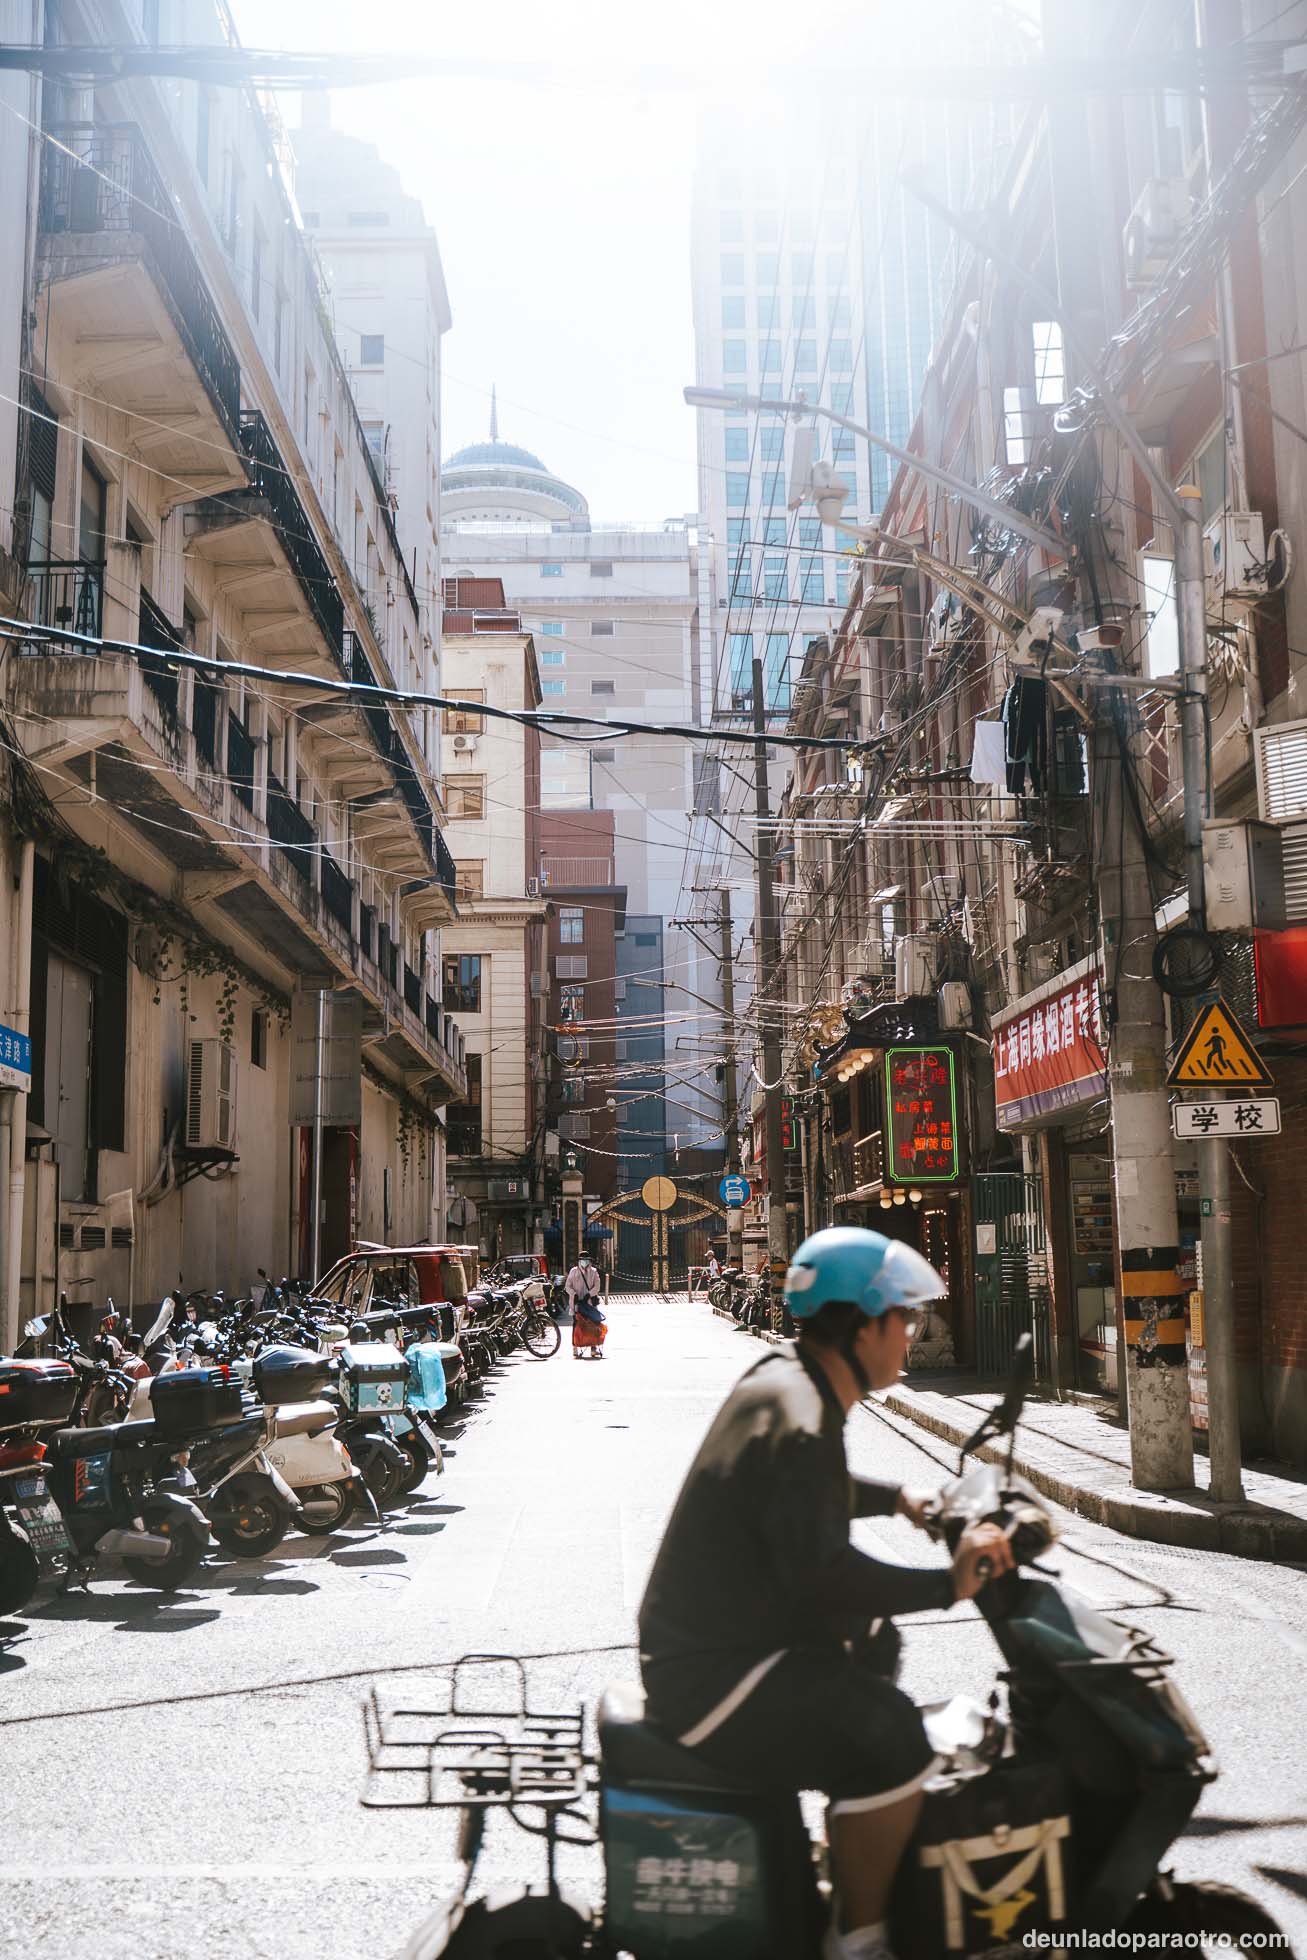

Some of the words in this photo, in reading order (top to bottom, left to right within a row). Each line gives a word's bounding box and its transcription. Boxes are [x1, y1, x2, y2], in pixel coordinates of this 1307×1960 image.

[914, 1121, 951, 1135] 上海菜
[1191, 1105, 1264, 1132] 学校
